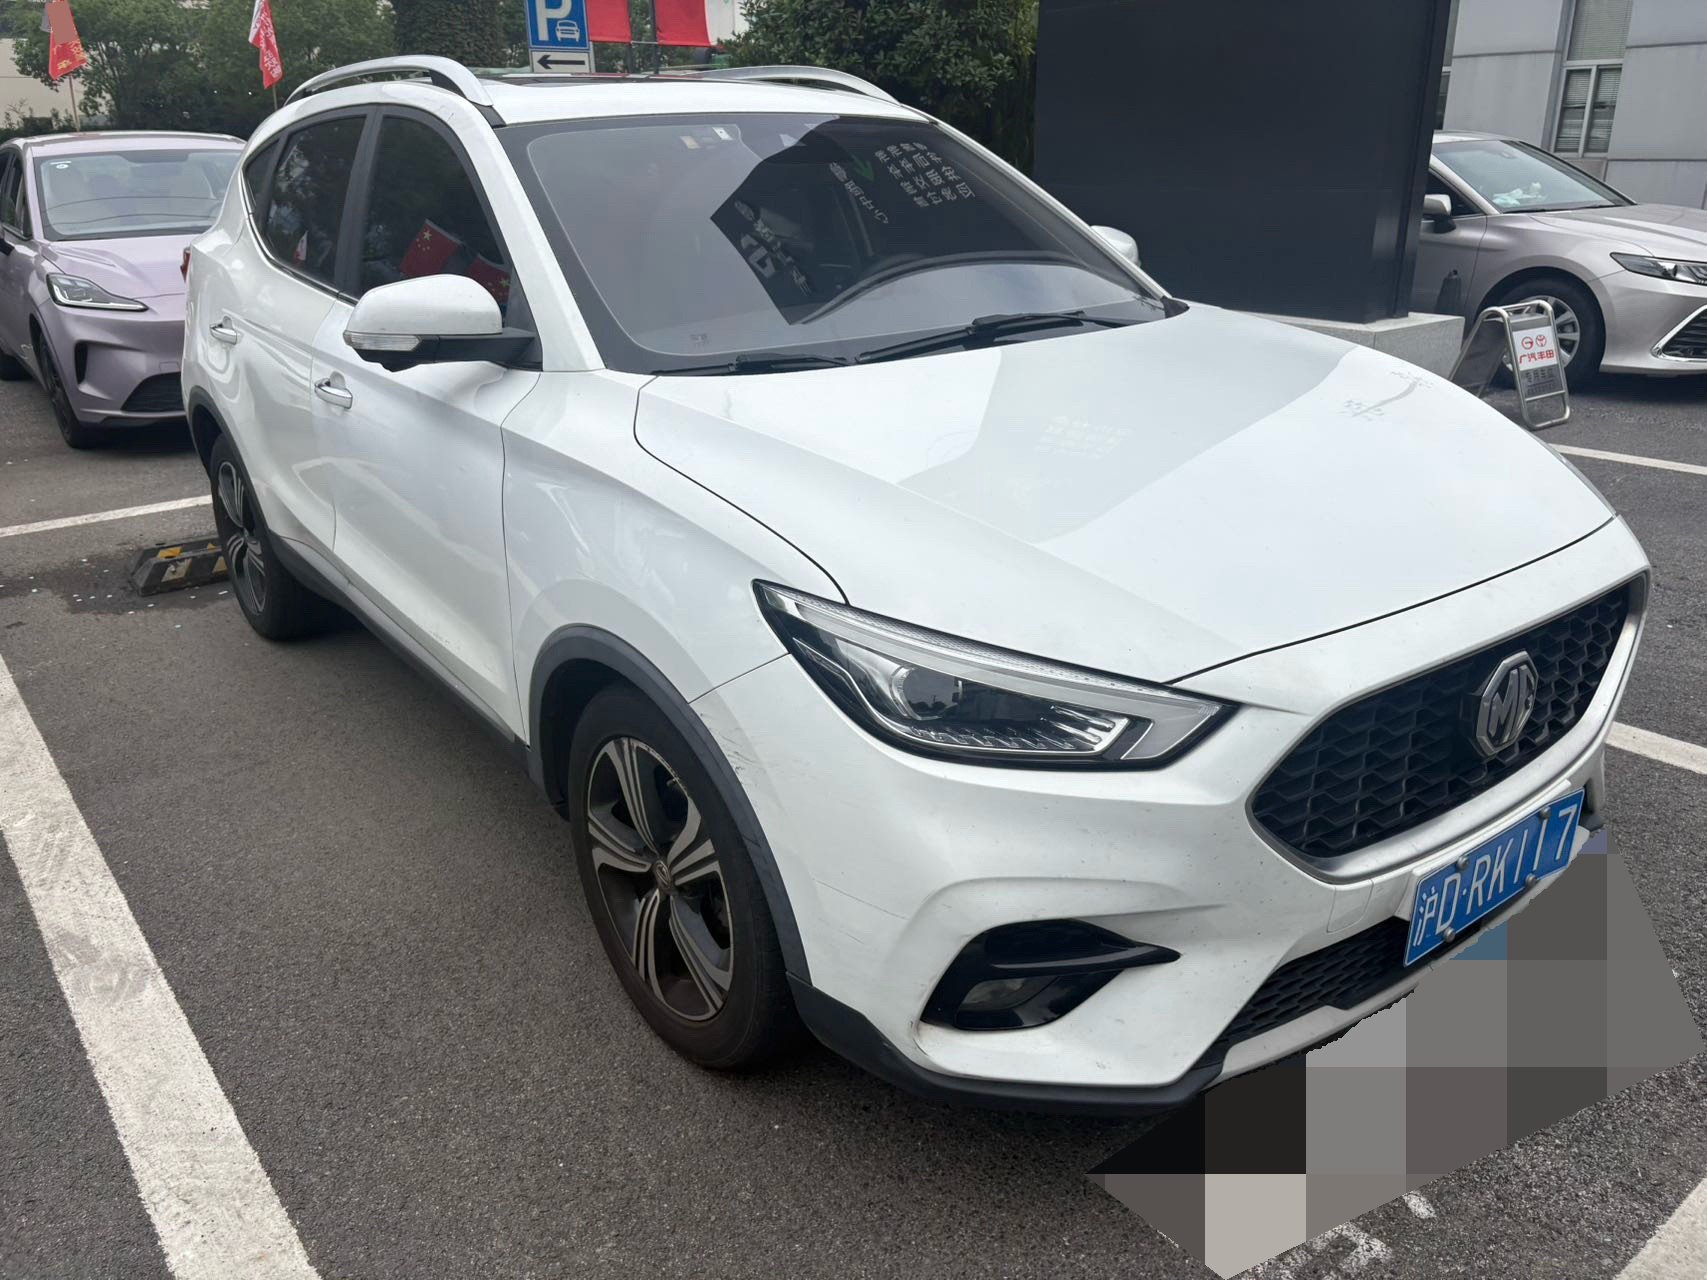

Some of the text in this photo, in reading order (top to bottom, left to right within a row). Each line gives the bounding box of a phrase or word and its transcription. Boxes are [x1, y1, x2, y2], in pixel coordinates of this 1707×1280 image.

[535, 0, 571, 42] P
[1519, 349, 1555, 364] 广汽丰田
